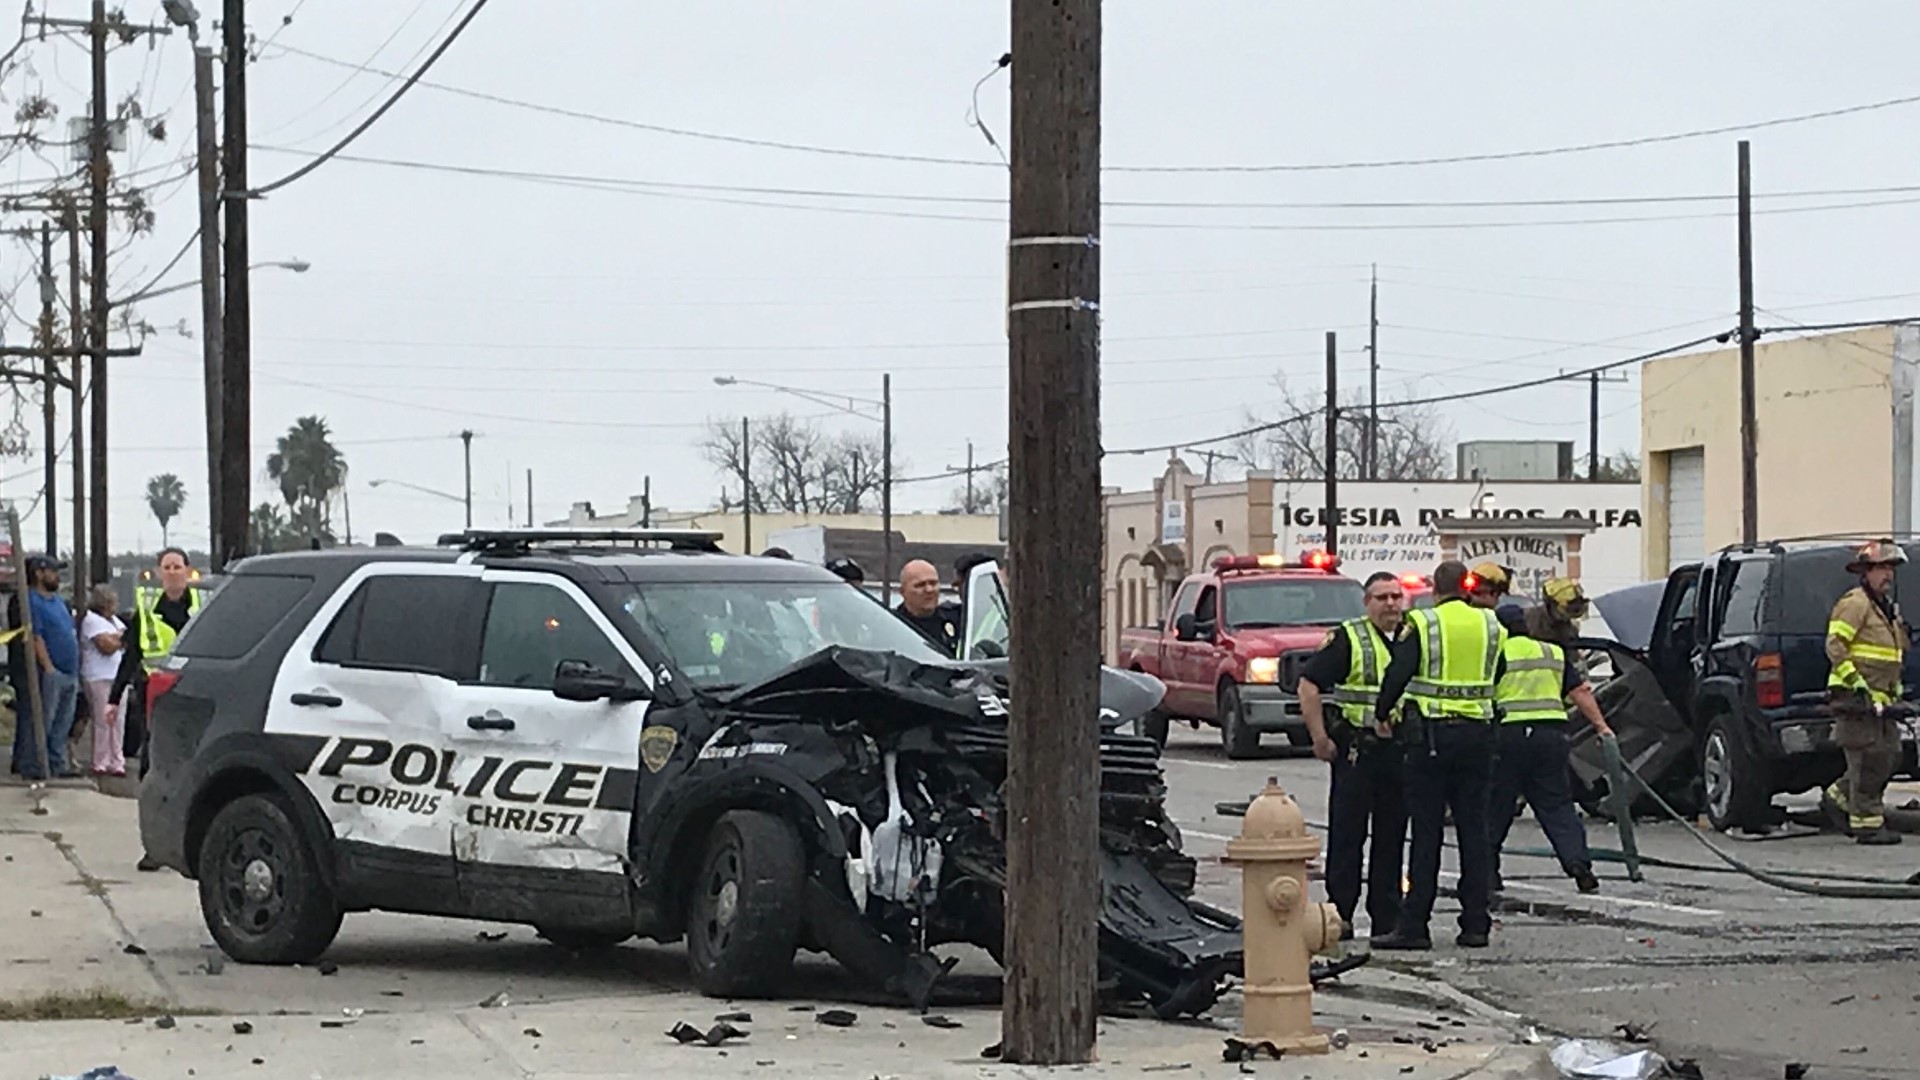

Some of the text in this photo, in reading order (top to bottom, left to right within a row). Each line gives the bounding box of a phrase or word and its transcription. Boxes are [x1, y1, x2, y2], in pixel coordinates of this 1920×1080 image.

[1283, 507, 1402, 527] IGLESIA
[1562, 508, 1642, 528] ALFA
[1339, 533, 1390, 546] WORSHIP
[1461, 538, 1501, 562] ALFA
[1499, 536, 1512, 554] Y
[1513, 536, 1564, 563] OMEGA
[1360, 549, 1396, 561] STUDY
[318, 737, 603, 808] POLICE
[331, 783, 586, 836] CORPUS CHRISTI
